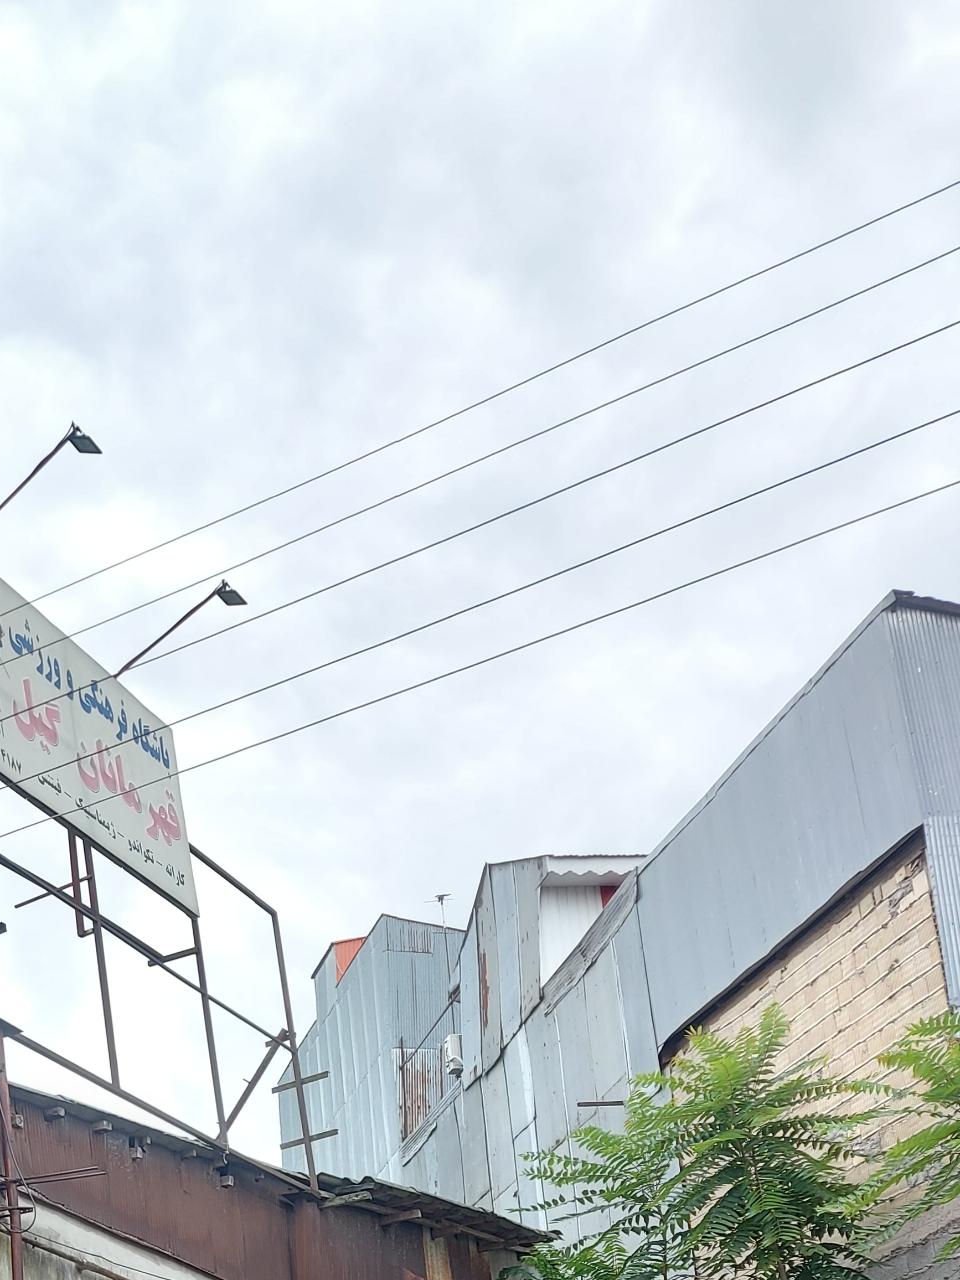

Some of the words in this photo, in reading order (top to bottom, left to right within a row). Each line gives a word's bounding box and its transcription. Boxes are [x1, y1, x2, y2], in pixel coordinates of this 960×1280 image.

[9, 618, 62, 690] ورزشی
[66, 669, 75, 701] و
[79, 679, 128, 741] فرهنگی
[133, 718, 171, 780] باشگاه
[76, 739, 181, 846] قهرمانان
